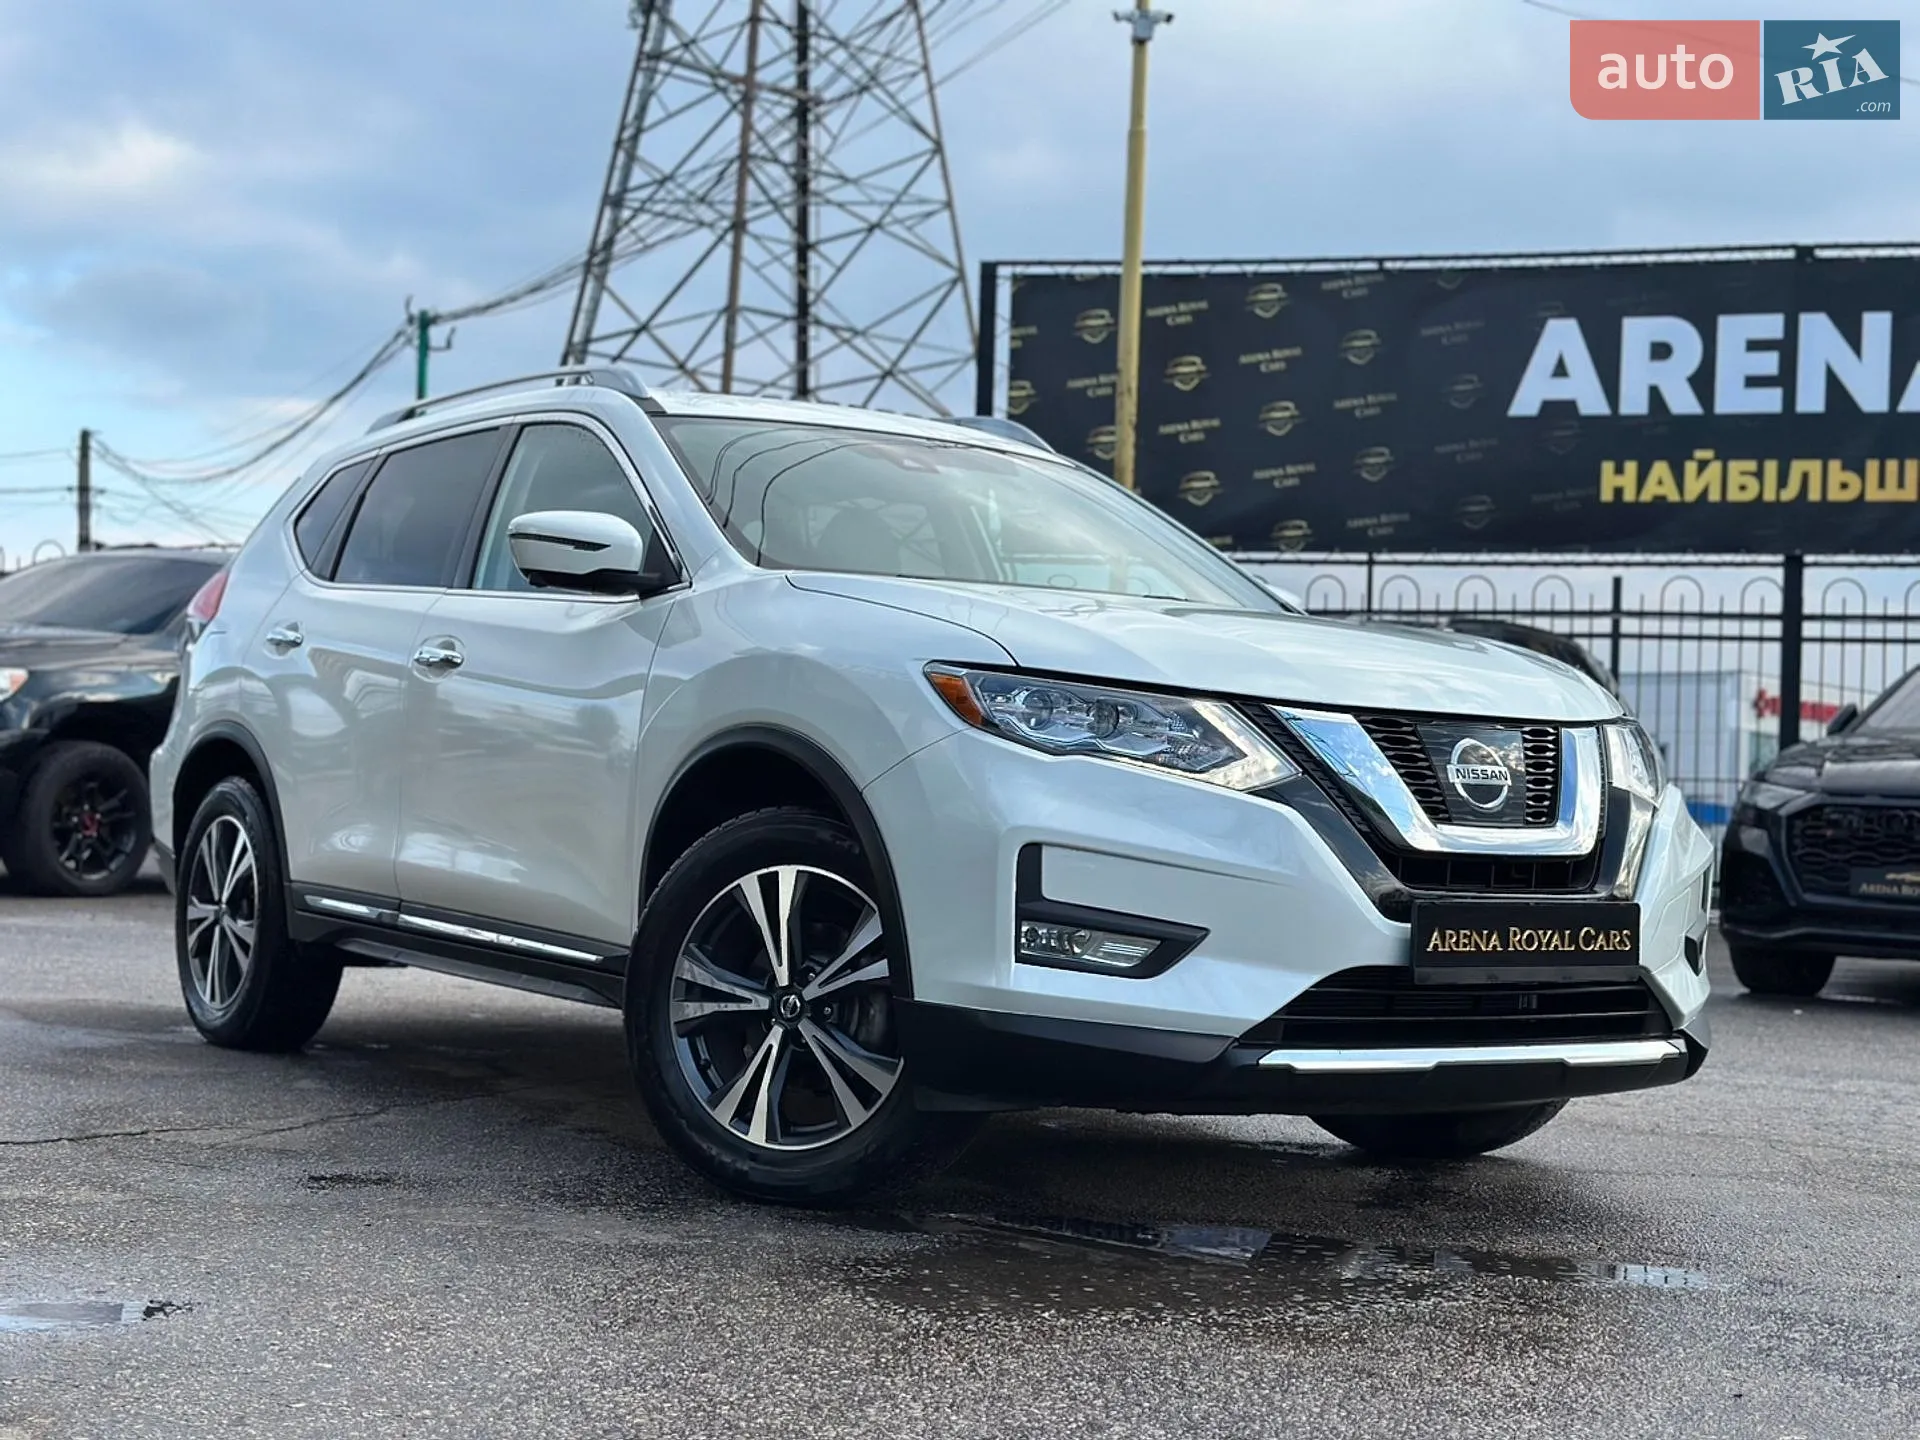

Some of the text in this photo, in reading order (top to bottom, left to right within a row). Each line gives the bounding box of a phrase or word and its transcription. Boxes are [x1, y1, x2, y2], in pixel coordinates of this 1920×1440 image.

[1507, 311, 1920, 417] AREN
[1600, 449, 1918, 503] НАЙБІЛЬШ
[1455, 768, 1508, 782] NISSAN
[1427, 927, 1631, 951] ARENA ROYAL CARS
